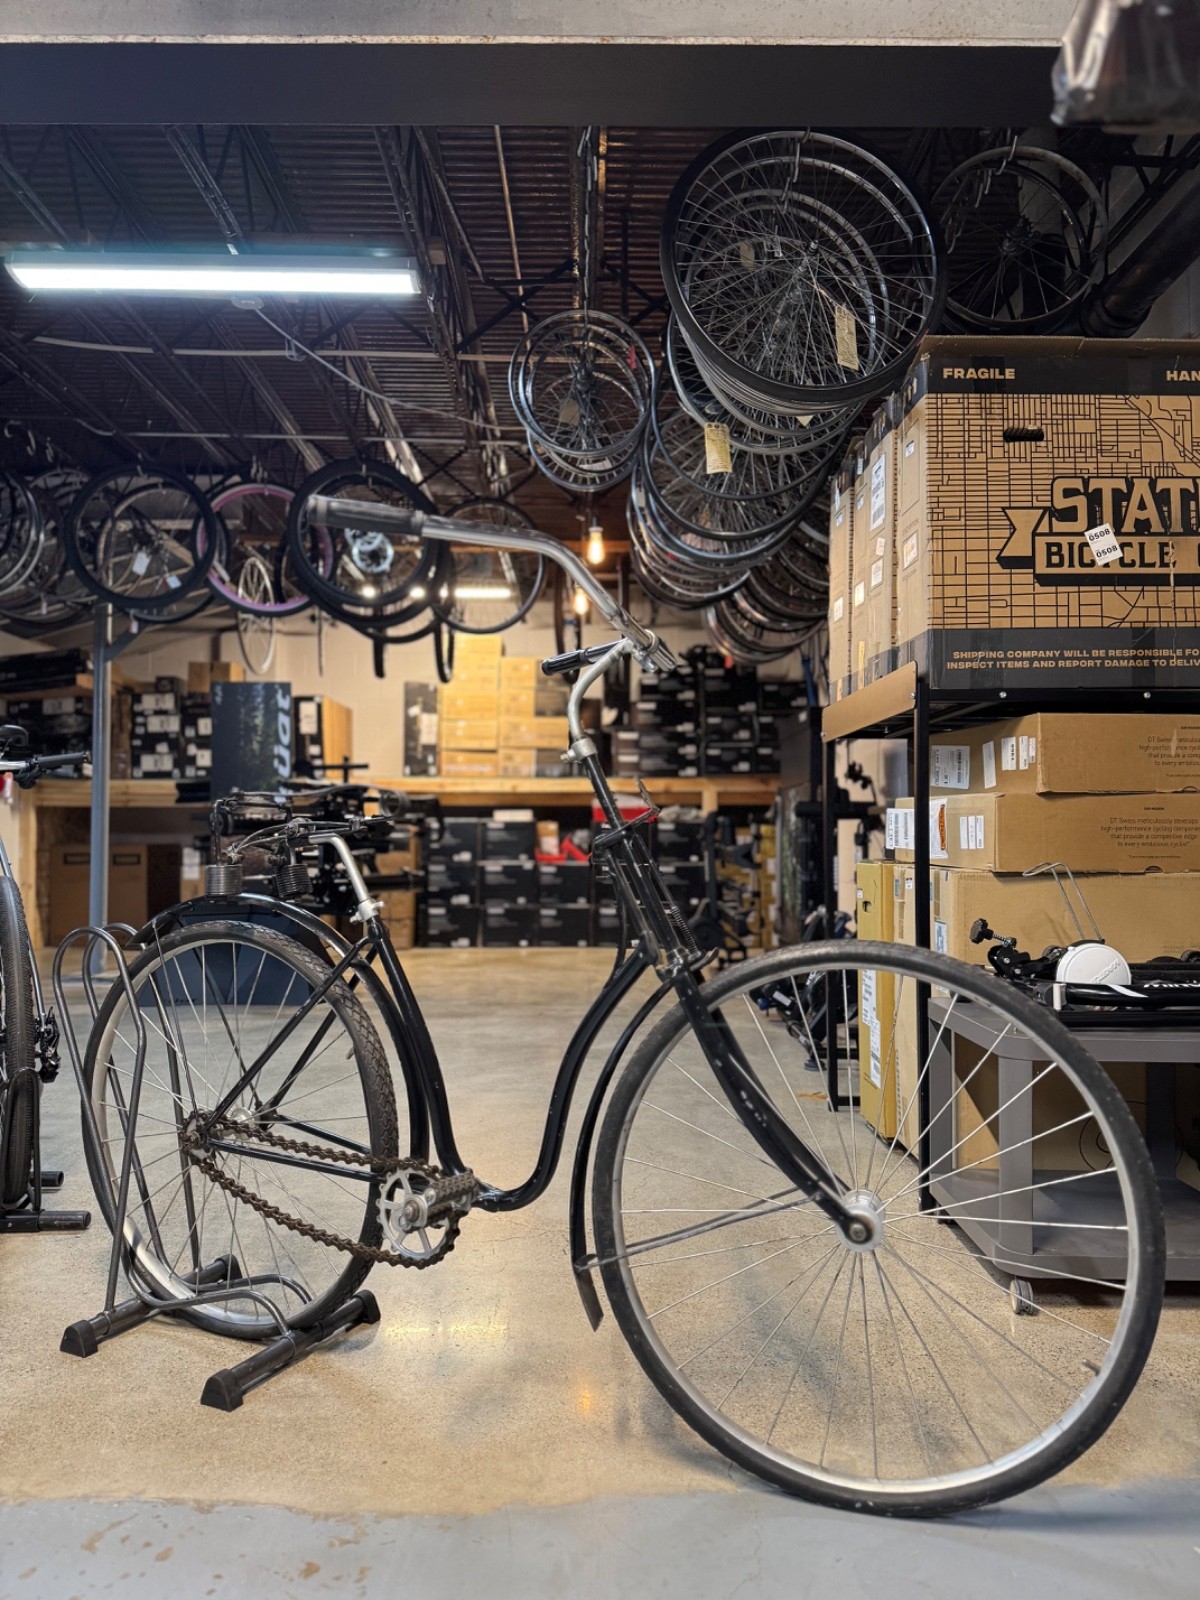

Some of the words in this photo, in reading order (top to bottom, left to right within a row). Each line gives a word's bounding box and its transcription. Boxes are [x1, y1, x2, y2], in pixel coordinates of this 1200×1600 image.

[943, 368, 1016, 380] FRAGILE
[1166, 370, 1200, 381] HAN
[1051, 477, 1200, 534] STAT
[1088, 528, 1111, 542] 0508
[1045, 541, 1177, 569] BICCLE
[1096, 545, 1118, 558] 0508
[953, 651, 1004, 659] SHIPPING
[1007, 650, 1061, 659] COMPANY
[1064, 650, 1090, 658] WILL
[1091, 650, 1106, 658] BE
[1108, 649, 1183, 658] RESPONSIBLE
[947, 661, 994, 670] INSPECT
[997, 660, 1030, 669] ITEMS
[1032, 660, 1057, 668] AND
[1058, 659, 1102, 668] REPORT
[1104, 659, 1150, 667] DAMAGE
[1152, 658, 1167, 667] TO
